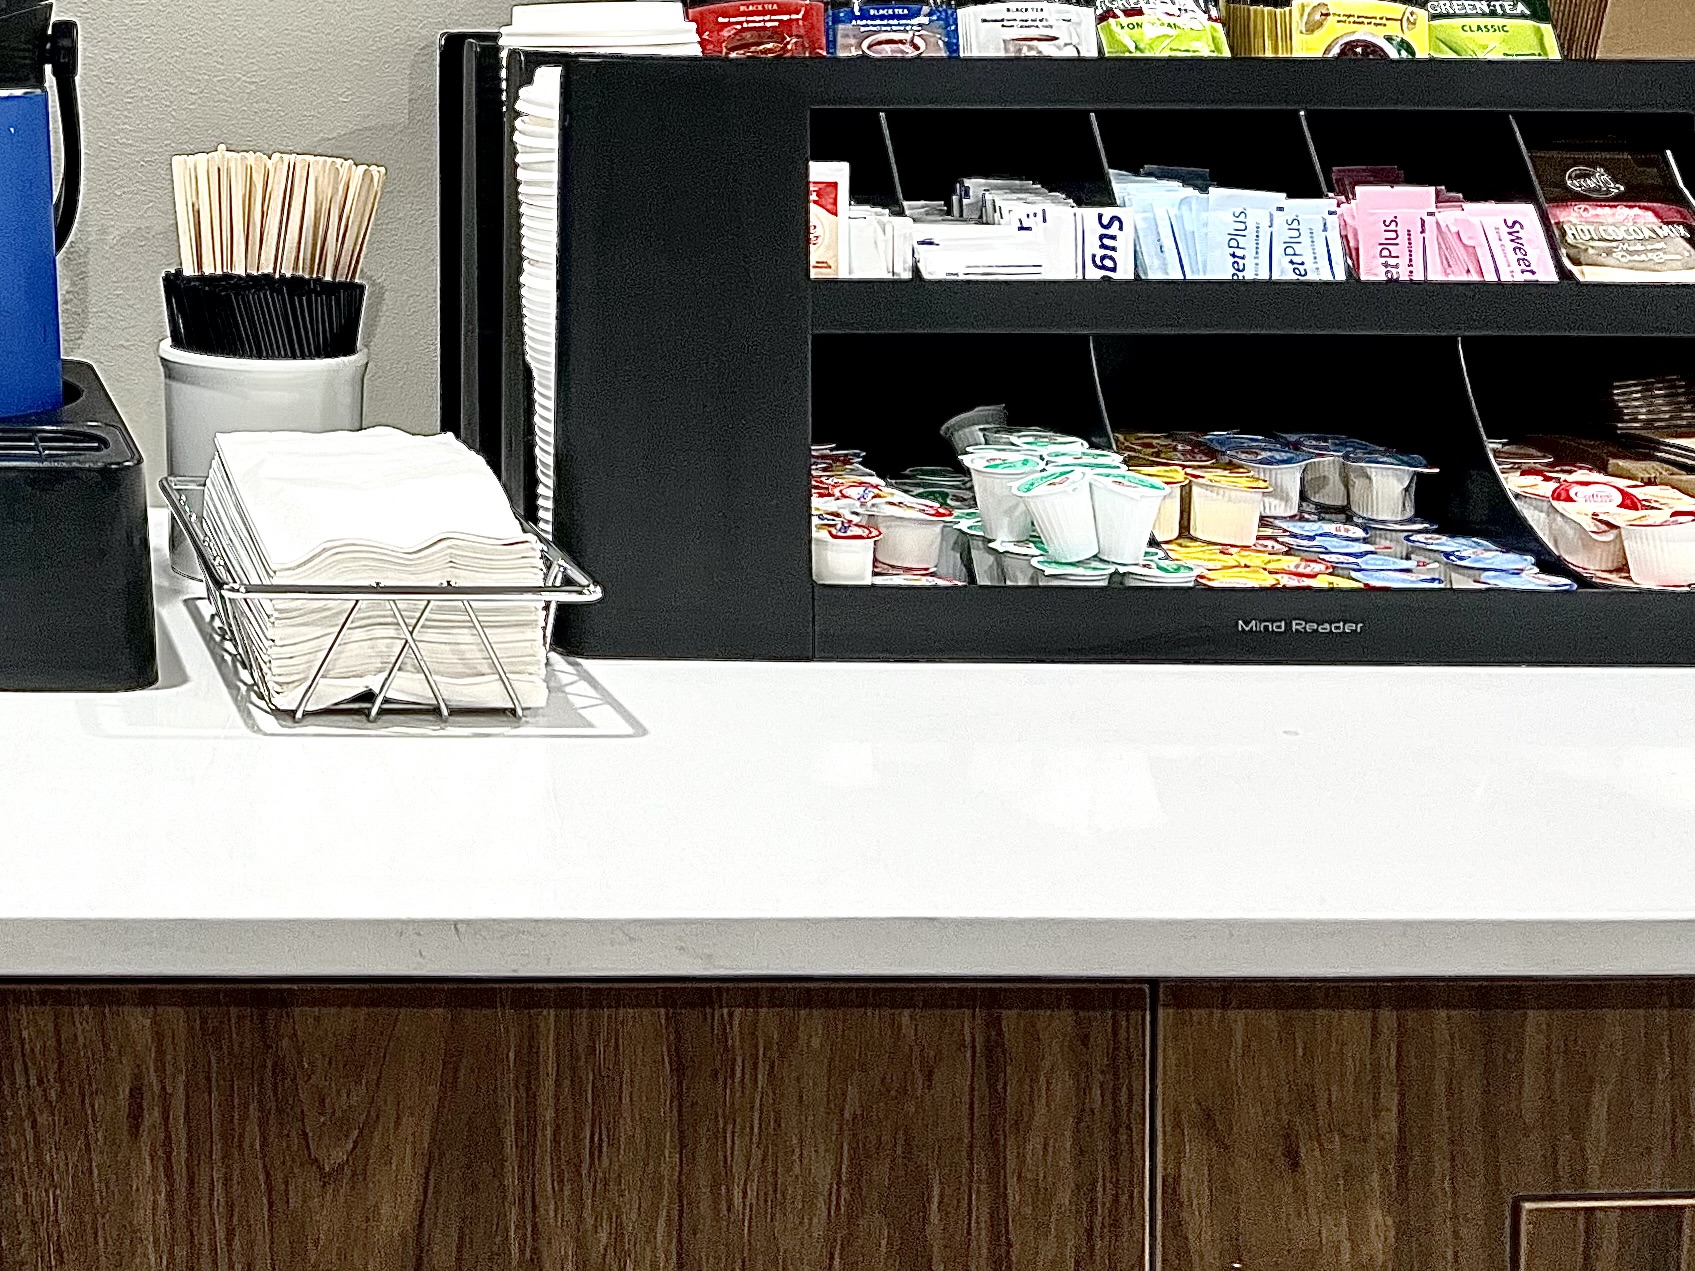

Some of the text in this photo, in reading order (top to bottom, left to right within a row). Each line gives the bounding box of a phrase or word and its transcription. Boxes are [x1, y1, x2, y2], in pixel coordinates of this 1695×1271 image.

[1428, 1, 1530, 14] GREEN TEA
[1461, 24, 1510, 33] CLASSIC
[1564, 225, 1599, 241] HOT
[1599, 225, 1656, 241] COCOA
[1091, 212, 1124, 279] Sug
[1503, 218, 1537, 277] Sweet
[1238, 620, 1364, 633] Mind Reader
